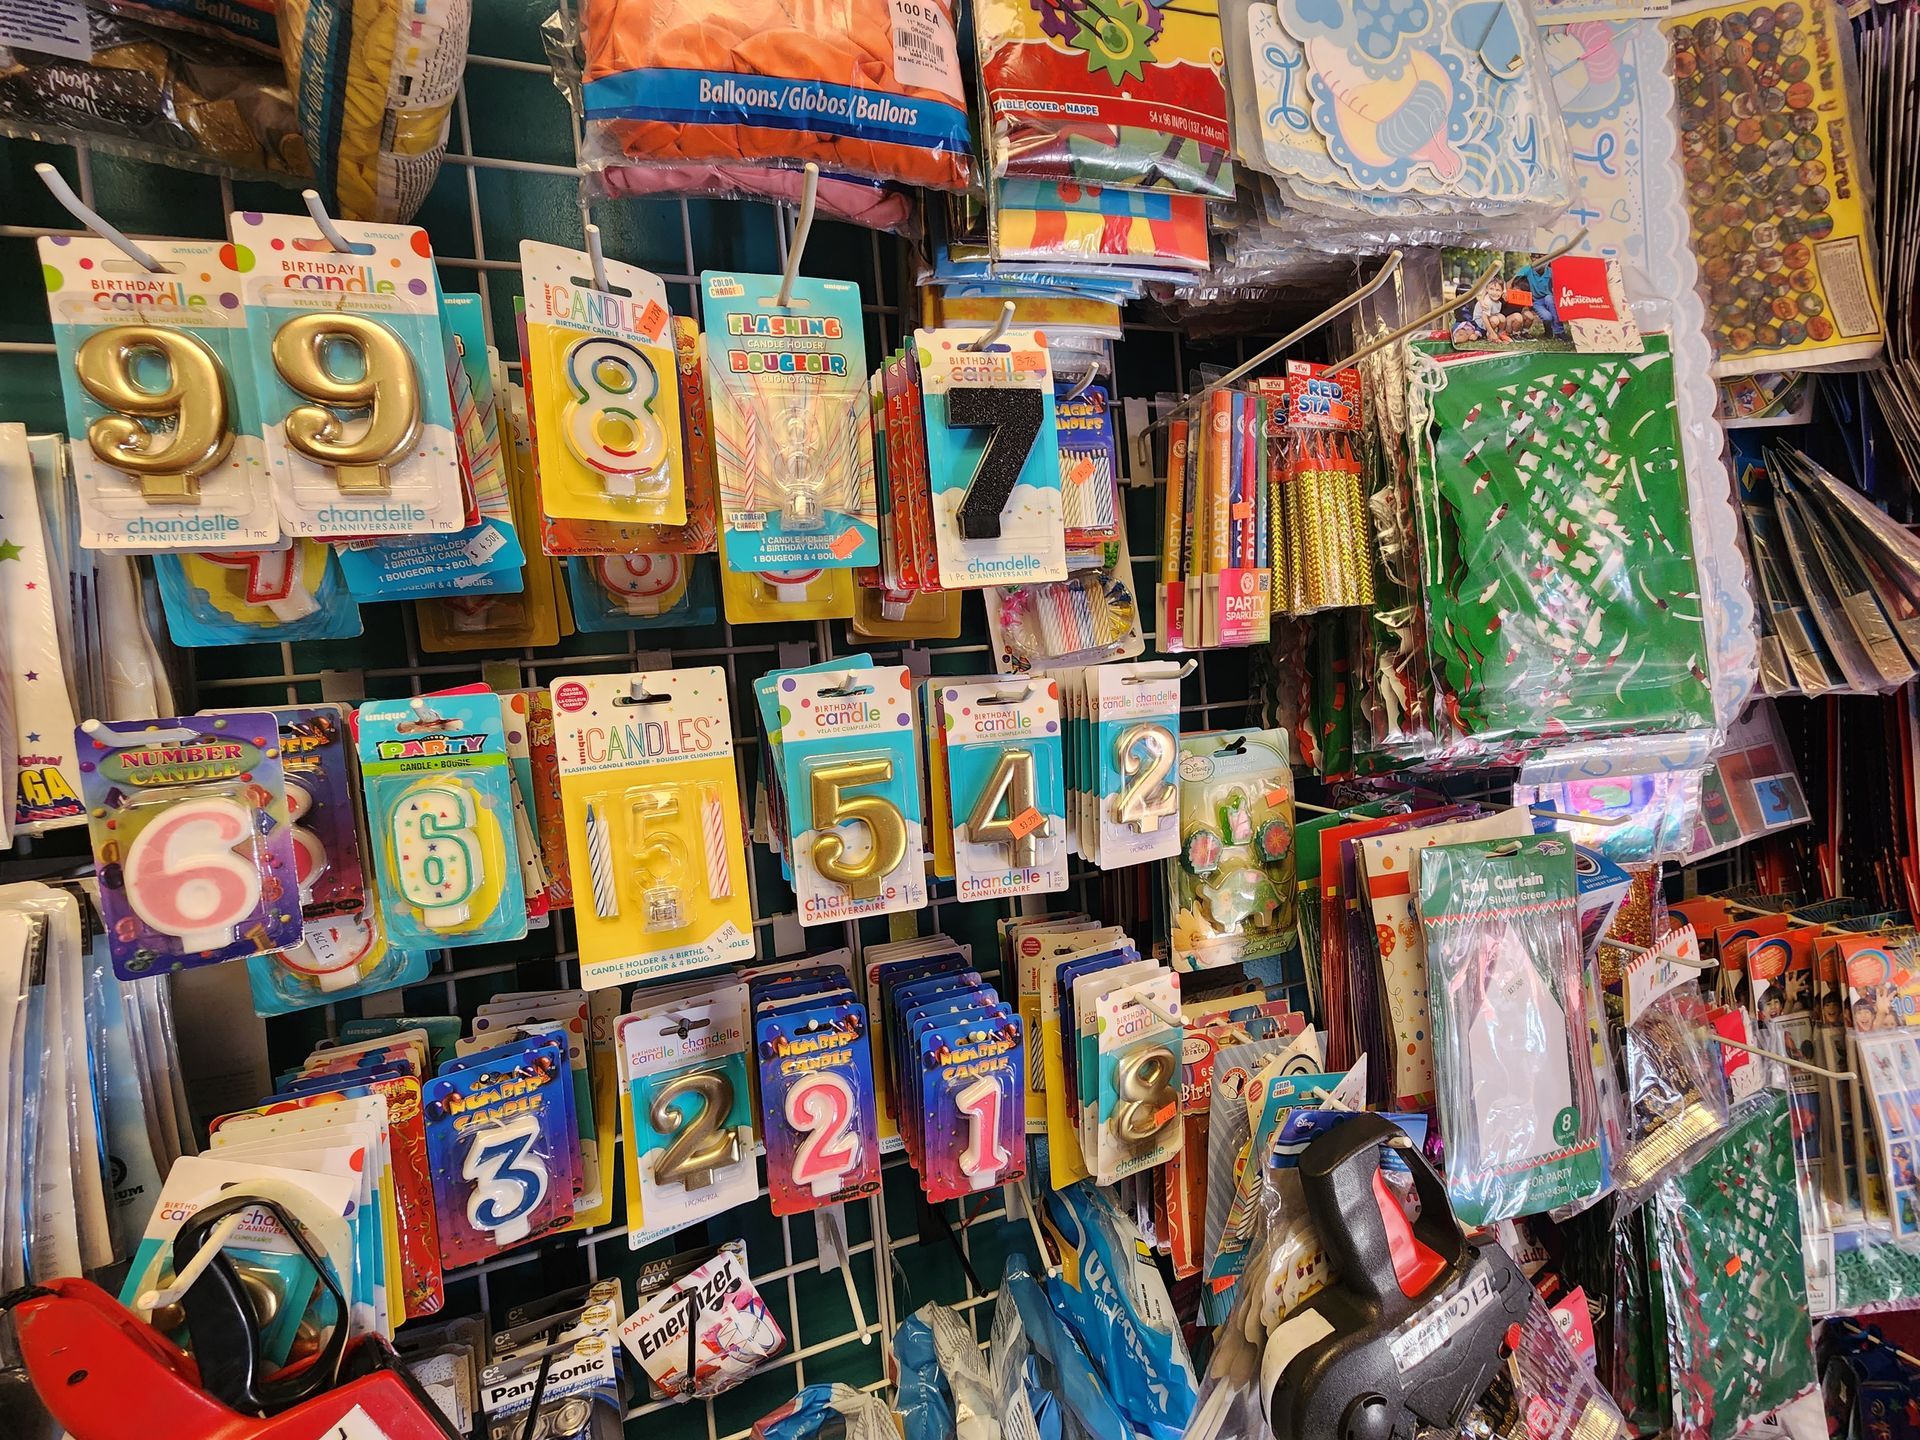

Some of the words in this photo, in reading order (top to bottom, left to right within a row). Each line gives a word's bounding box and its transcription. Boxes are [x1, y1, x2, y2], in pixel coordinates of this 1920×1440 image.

[896, 1, 919, 16] 100
[924, 8, 940, 27] EA
[1026, 100, 1059, 112] COVER
[1066, 103, 1099, 116] NAPPE
[1149, 111, 1158, 123] 54
[282, 260, 355, 275] BIRTHDAY
[92, 280, 165, 291] BIRTHDAY
[284, 266, 396, 294] candle
[93, 282, 207, 313] candle
[544, 282, 552, 316] unique
[1560, 295, 1604, 308] Mexicana
[1562, 287, 1573, 298] La
[552, 286, 645, 334] CANDLE
[556, 319, 590, 332] BIRTHDAY
[593, 326, 619, 337] CANDLE
[728, 314, 842, 338] FLASHING
[748, 339, 784, 348] CANDLE
[787, 340, 824, 349] HOLDER
[729, 351, 847, 376] BOUGEOIR
[950, 357, 998, 366] BIRTHDAY
[951, 357, 1025, 382] candle
[1307, 378, 1342, 399] RED
[945, 387, 1045, 538] 7
[317, 504, 426, 523] chandelle
[127, 515, 239, 534] chandelle
[320, 522, 413, 532] D'ANNIVERSAIRE
[439, 520, 452, 529] mc
[1214, 493, 1229, 558] PARTY
[128, 533, 227, 542] D'ANNIVERSAIRE
[254, 530, 268, 538] mc
[1168, 512, 1181, 572] PARTY
[390, 546, 427, 560] CANDLE
[429, 540, 466, 553] HOLDER
[760, 554, 802, 562] BOUGEOIR
[392, 554, 436, 569] BIRTHDAY
[968, 555, 1040, 573] chandelle
[386, 566, 434, 581] BOUGEOIR
[970, 570, 1032, 580] D'ANNIVERSAIRE
[1226, 596, 1266, 611] PARTY
[1226, 610, 1264, 620] SPARKLERS
[1103, 698, 1131, 709] candle
[1136, 690, 1178, 702] chandelle
[365, 711, 406, 721] unique
[815, 702, 857, 712] BIRTHDAY
[816, 702, 880, 726] candle
[974, 711, 1011, 720] BIRTHDAY
[975, 710, 1031, 732] candle
[378, 735, 487, 760] PARTY
[577, 728, 586, 765] unique
[586, 716, 712, 763] CANDLES
[120, 744, 242, 768] NUMBER
[564, 763, 597, 774] FLASHING
[599, 761, 624, 770] CANDLE
[625, 759, 650, 768] HOLDER
[656, 755, 689, 764] BOUGEOIR
[690, 750, 728, 759] CLIGNOTANT
[129, 762, 240, 785] CANDLE
[400, 761, 432, 772] CANDLE
[1183, 757, 1212, 776] Disney
[961, 868, 1041, 891] chandelle
[1494, 872, 1544, 890] Curtain
[963, 885, 1031, 899] D'ANNIVERSAIRE
[806, 901, 885, 921] D'ANNIVERSAIRE
[591, 964, 624, 976] CANDLE
[626, 957, 659, 968] HOLDER
[676, 948, 704, 959] BIRTHD
[625, 964, 669, 977] BOUGEOIR
[1117, 1008, 1148, 1025] BIRTHDAY
[1117, 1012, 1162, 1037] candl
[682, 1029, 739, 1049] chandelle
[777, 1032, 853, 1059] NUMBER
[632, 1046, 662, 1057] BIRTHDAY
[632, 1046, 674, 1065] candle
[940, 1039, 1010, 1067] NUMBER
[451, 1076, 543, 1116] NUMBER
[785, 1073, 859, 1186] 2
[1562, 1114, 1572, 1131] 8
[1116, 1146, 1164, 1172] chandelle
[462, 1116, 549, 1232] 3
[1546, 1167, 1572, 1181] PARTY
[637, 1227, 670, 1245] BOUGEOIR
[638, 1259, 732, 1360] Enerizer
[491, 1360, 604, 1403] Pansonic
